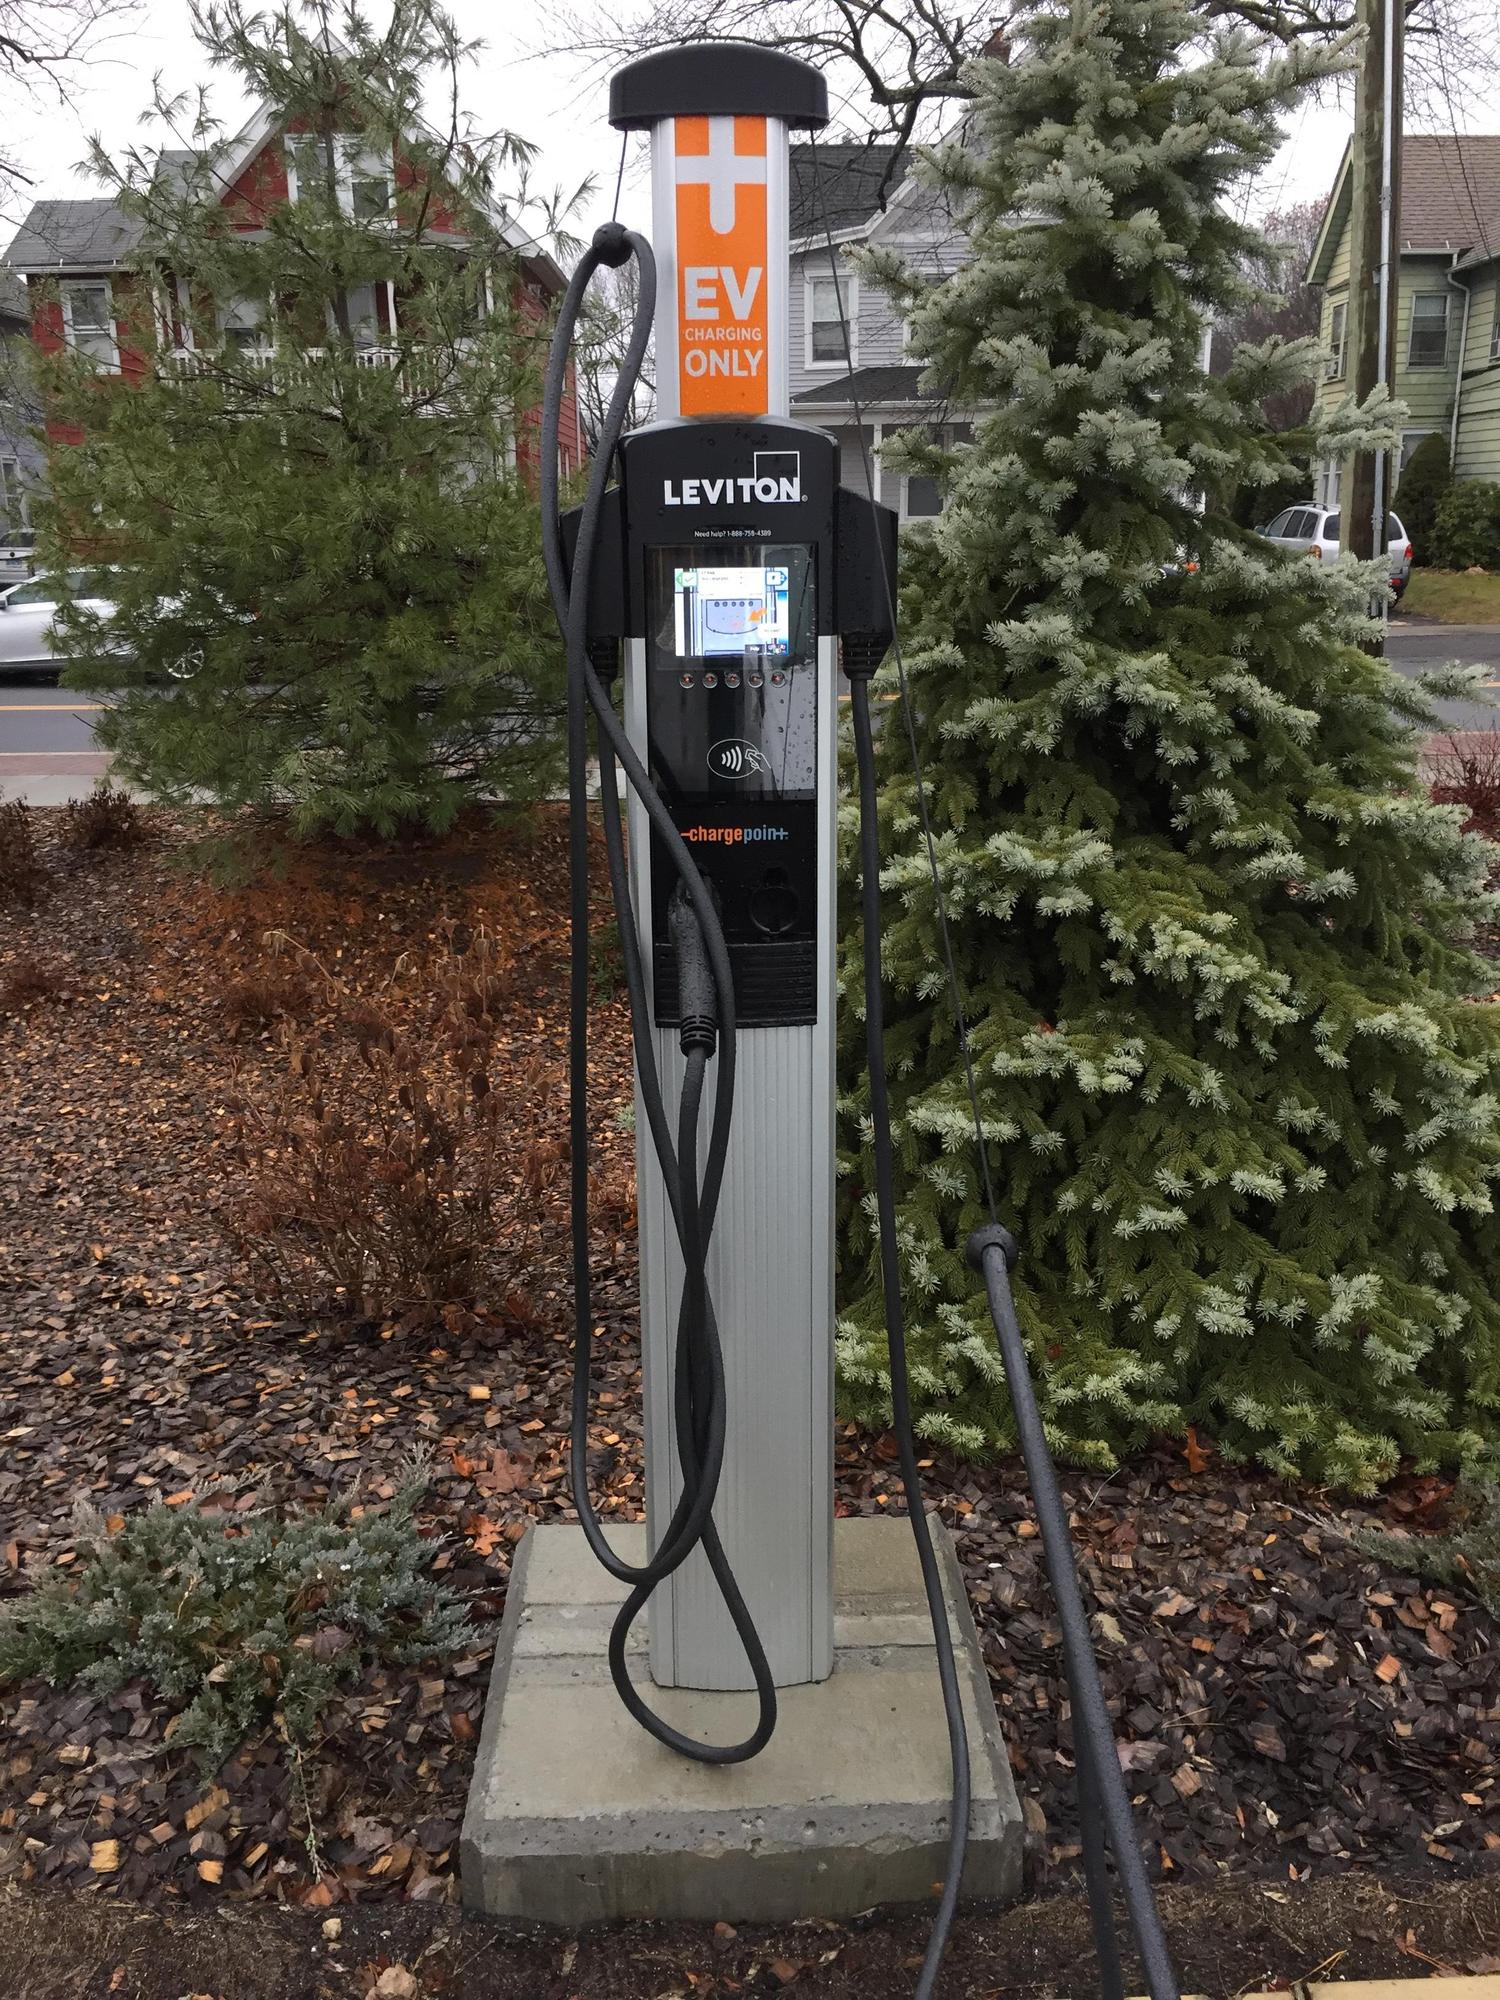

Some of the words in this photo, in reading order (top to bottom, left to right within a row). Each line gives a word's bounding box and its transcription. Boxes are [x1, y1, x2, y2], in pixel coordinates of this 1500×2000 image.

[684, 266, 762, 320] EV
[685, 328, 762, 341] CHARGING
[685, 349, 763, 377] ONLY
[664, 477, 800, 505] LEVITON
[694, 530, 710, 538] Need
[711, 530, 726, 538] help?
